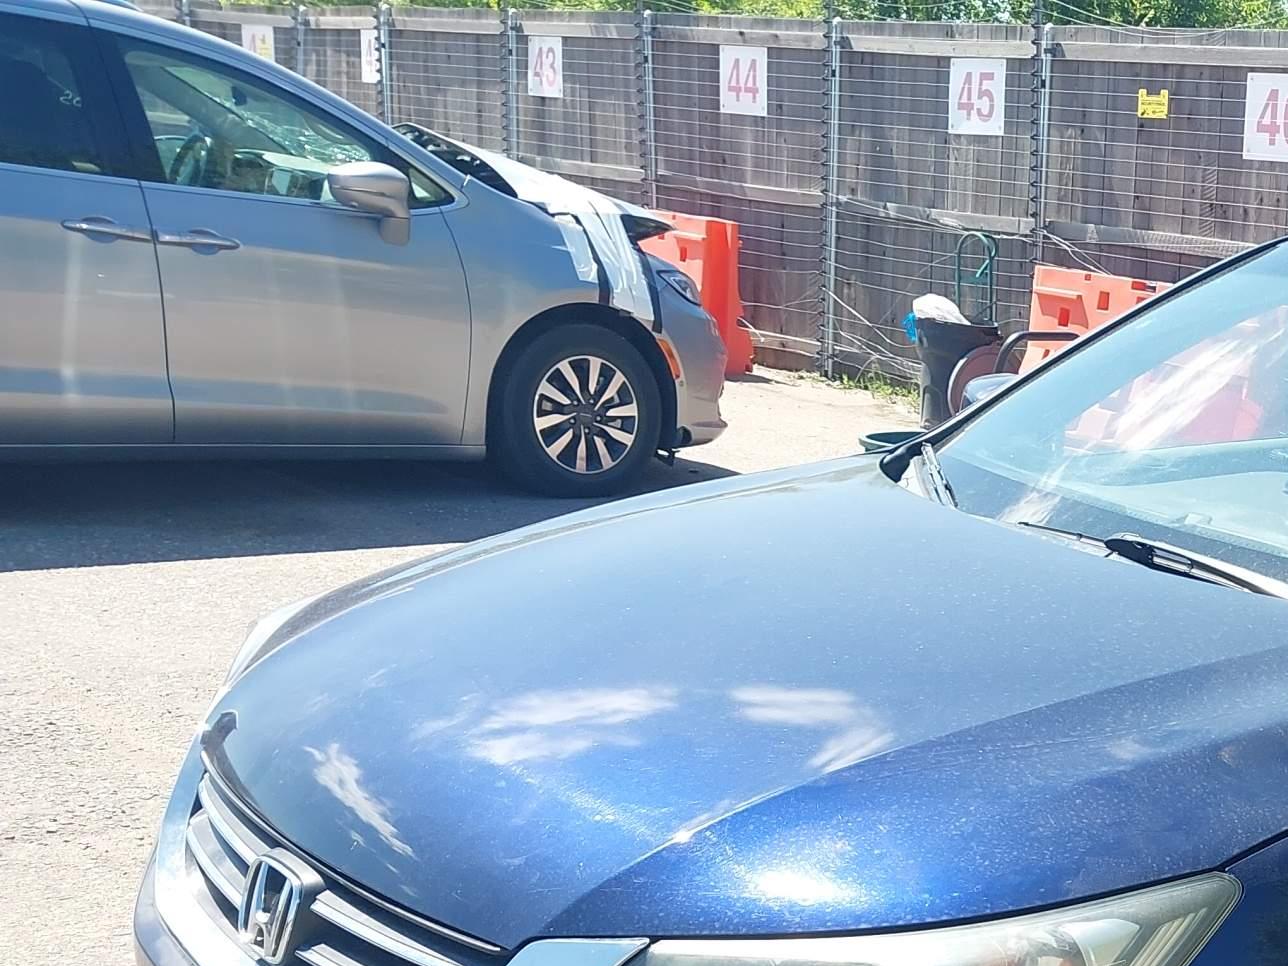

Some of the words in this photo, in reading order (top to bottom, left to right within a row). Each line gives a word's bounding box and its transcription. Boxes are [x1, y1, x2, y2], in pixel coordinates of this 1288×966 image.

[532, 46, 558, 88] 43
[727, 57, 760, 104] 44
[956, 71, 996, 123] 45
